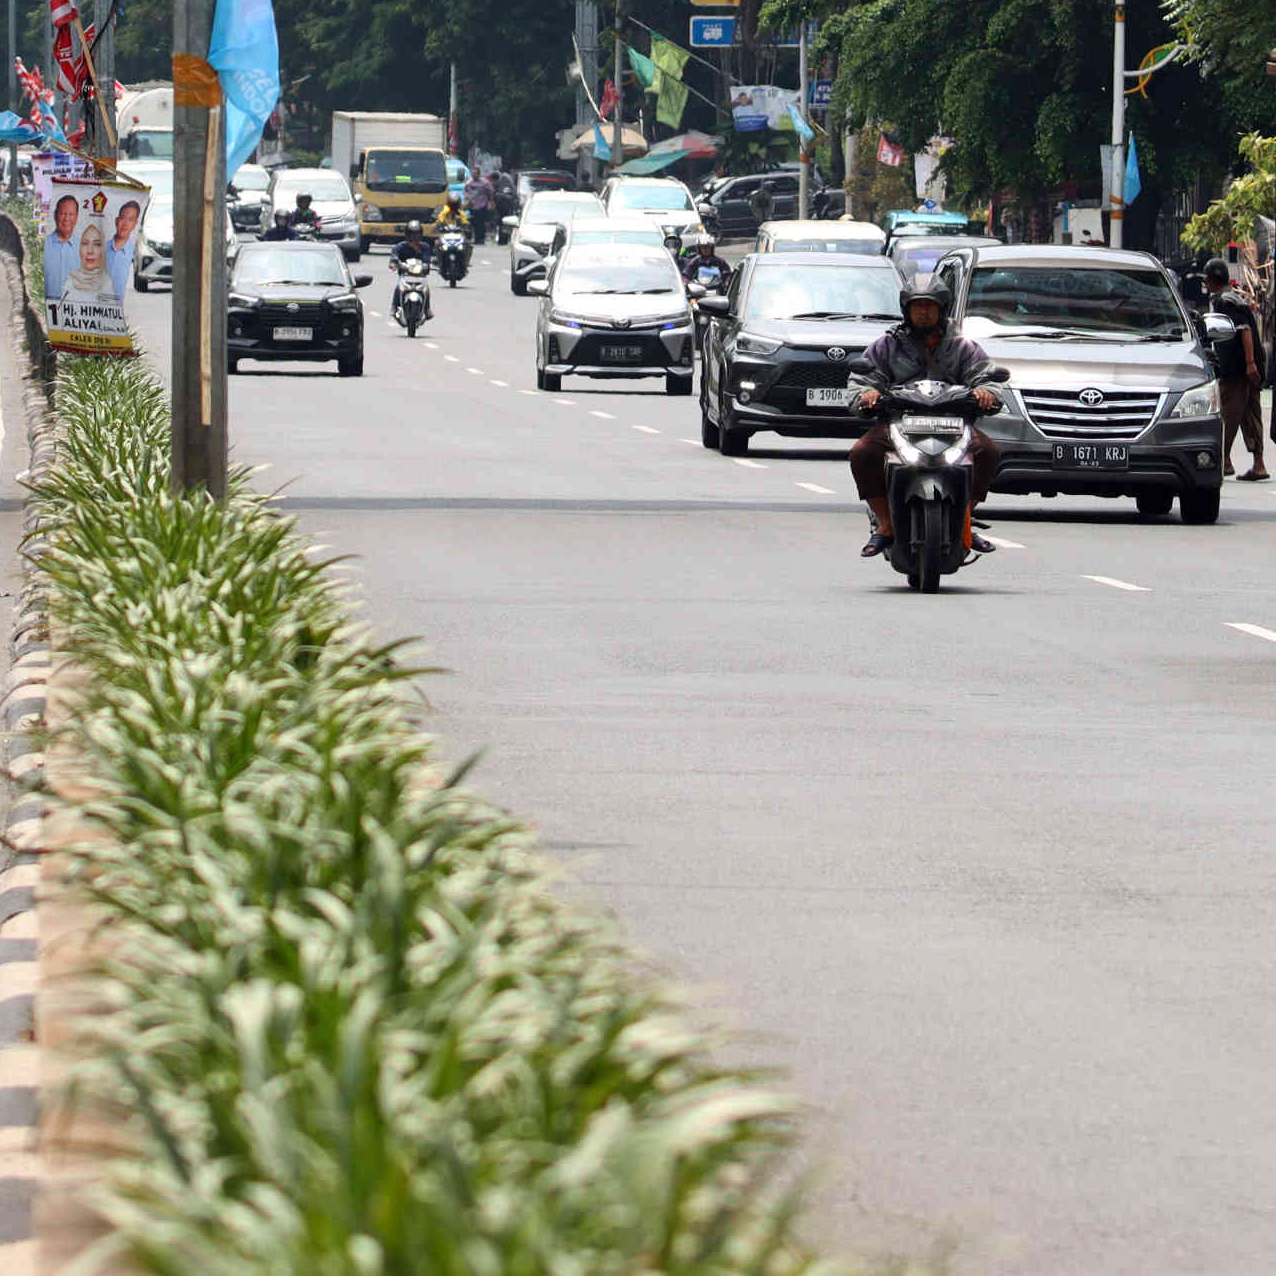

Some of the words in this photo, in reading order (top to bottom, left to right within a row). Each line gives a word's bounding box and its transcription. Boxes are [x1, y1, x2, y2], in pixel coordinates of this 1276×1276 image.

[808, 391, 815, 400] B
[1056, 446, 1064, 459] B
[1106, 444, 1126, 460] KRJ
